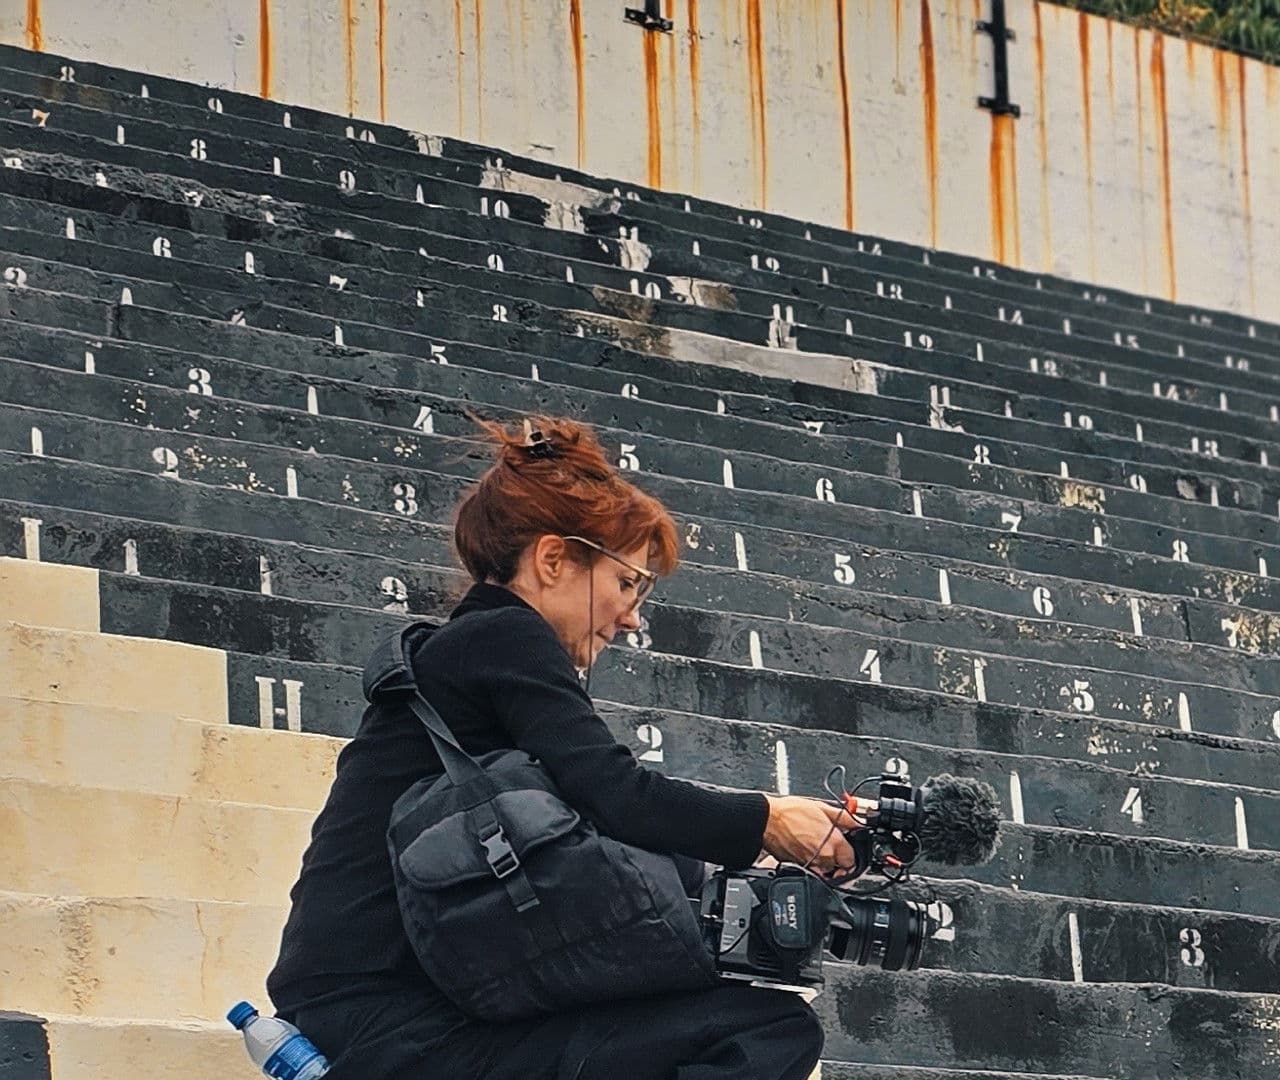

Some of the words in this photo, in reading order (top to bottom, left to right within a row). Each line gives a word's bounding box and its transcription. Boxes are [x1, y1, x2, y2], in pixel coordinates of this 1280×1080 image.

[33, 109, 49, 127] 7
[186, 369, 212, 396] 3
[410, 406, 437, 436] 4
[620, 444, 640, 472] 5
[816, 478, 836, 504] 6
[1002, 513, 1021, 533] 7
[1173, 540, 1189, 563] 8
[394, 484, 418, 515] 3
[834, 554, 855, 584] 5
[1033, 587, 1053, 616] 6
[123, 539, 142, 578] 1
[856, 649, 885, 686] 4
[1073, 680, 1094, 711] 5
[255, 677, 304, 730] H
[637, 725, 663, 762] 2
[1121, 788, 1143, 823] 4
[1180, 928, 1204, 966] 3
